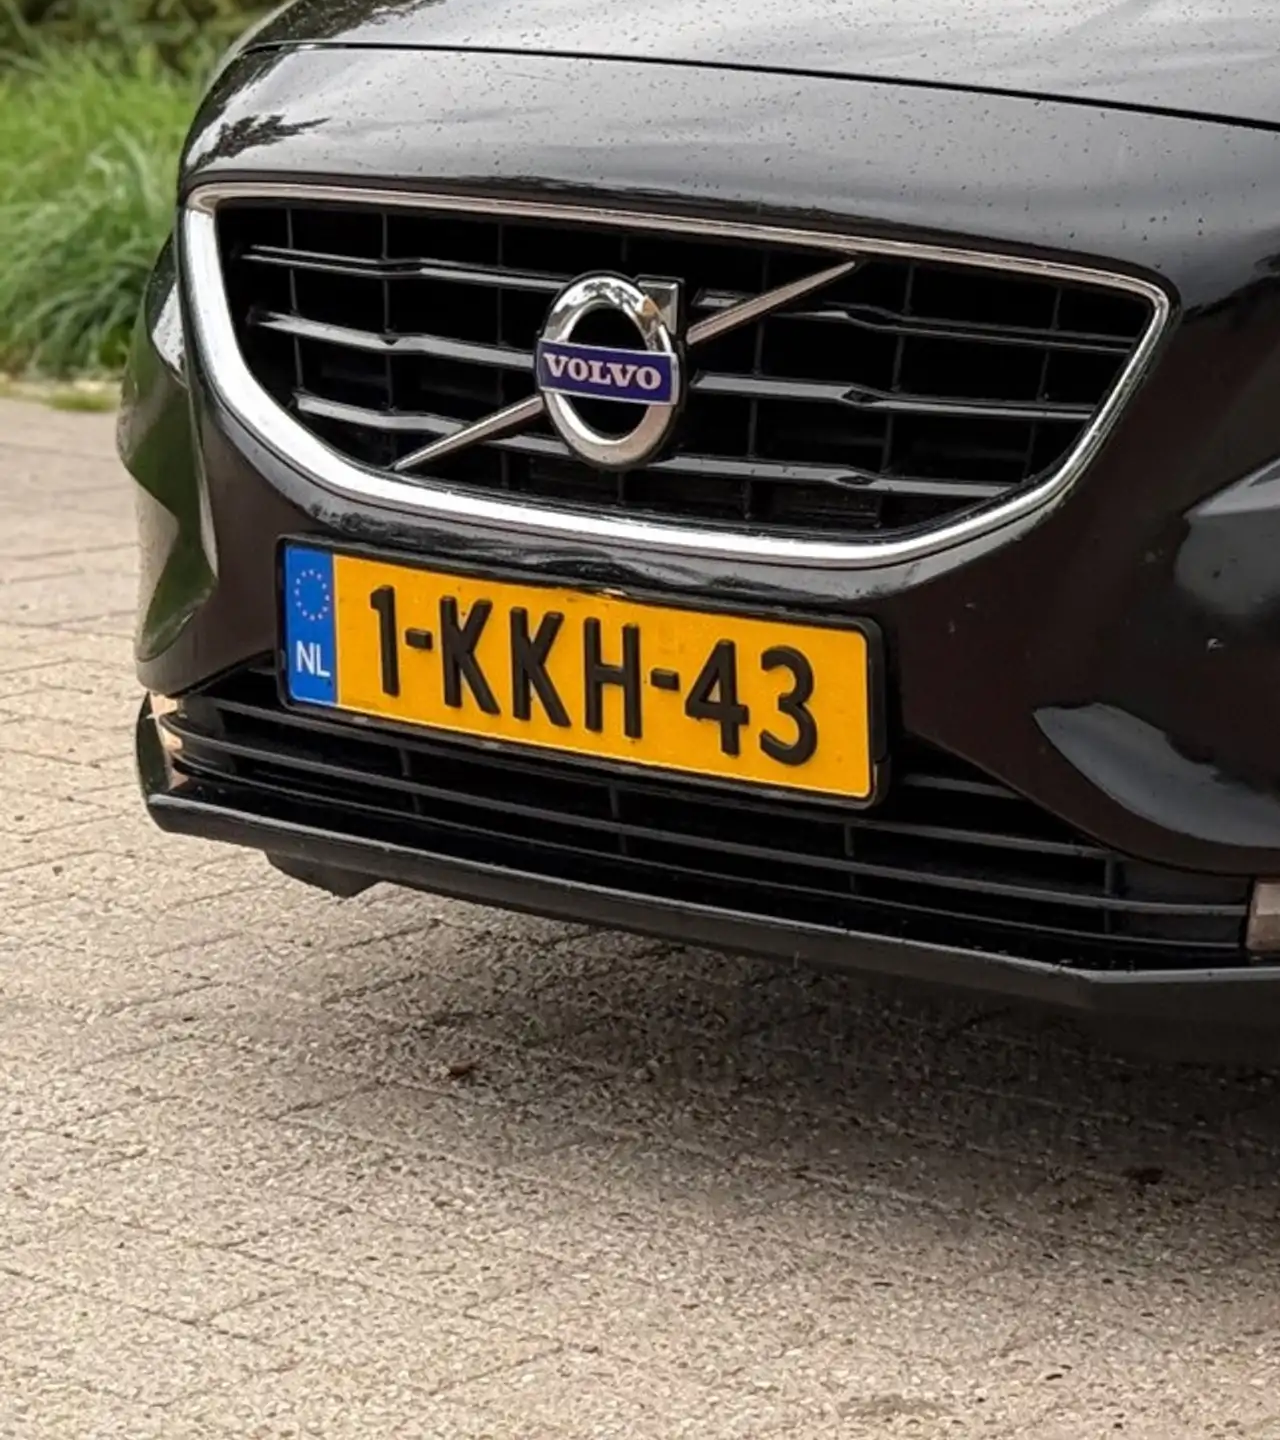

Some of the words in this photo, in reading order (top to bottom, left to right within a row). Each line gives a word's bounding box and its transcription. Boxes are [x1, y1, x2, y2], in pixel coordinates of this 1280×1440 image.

[543, 352, 662, 390] VOLVO
[296, 640, 330, 678] NL
[370, 584, 818, 766] 1-KKH-43
